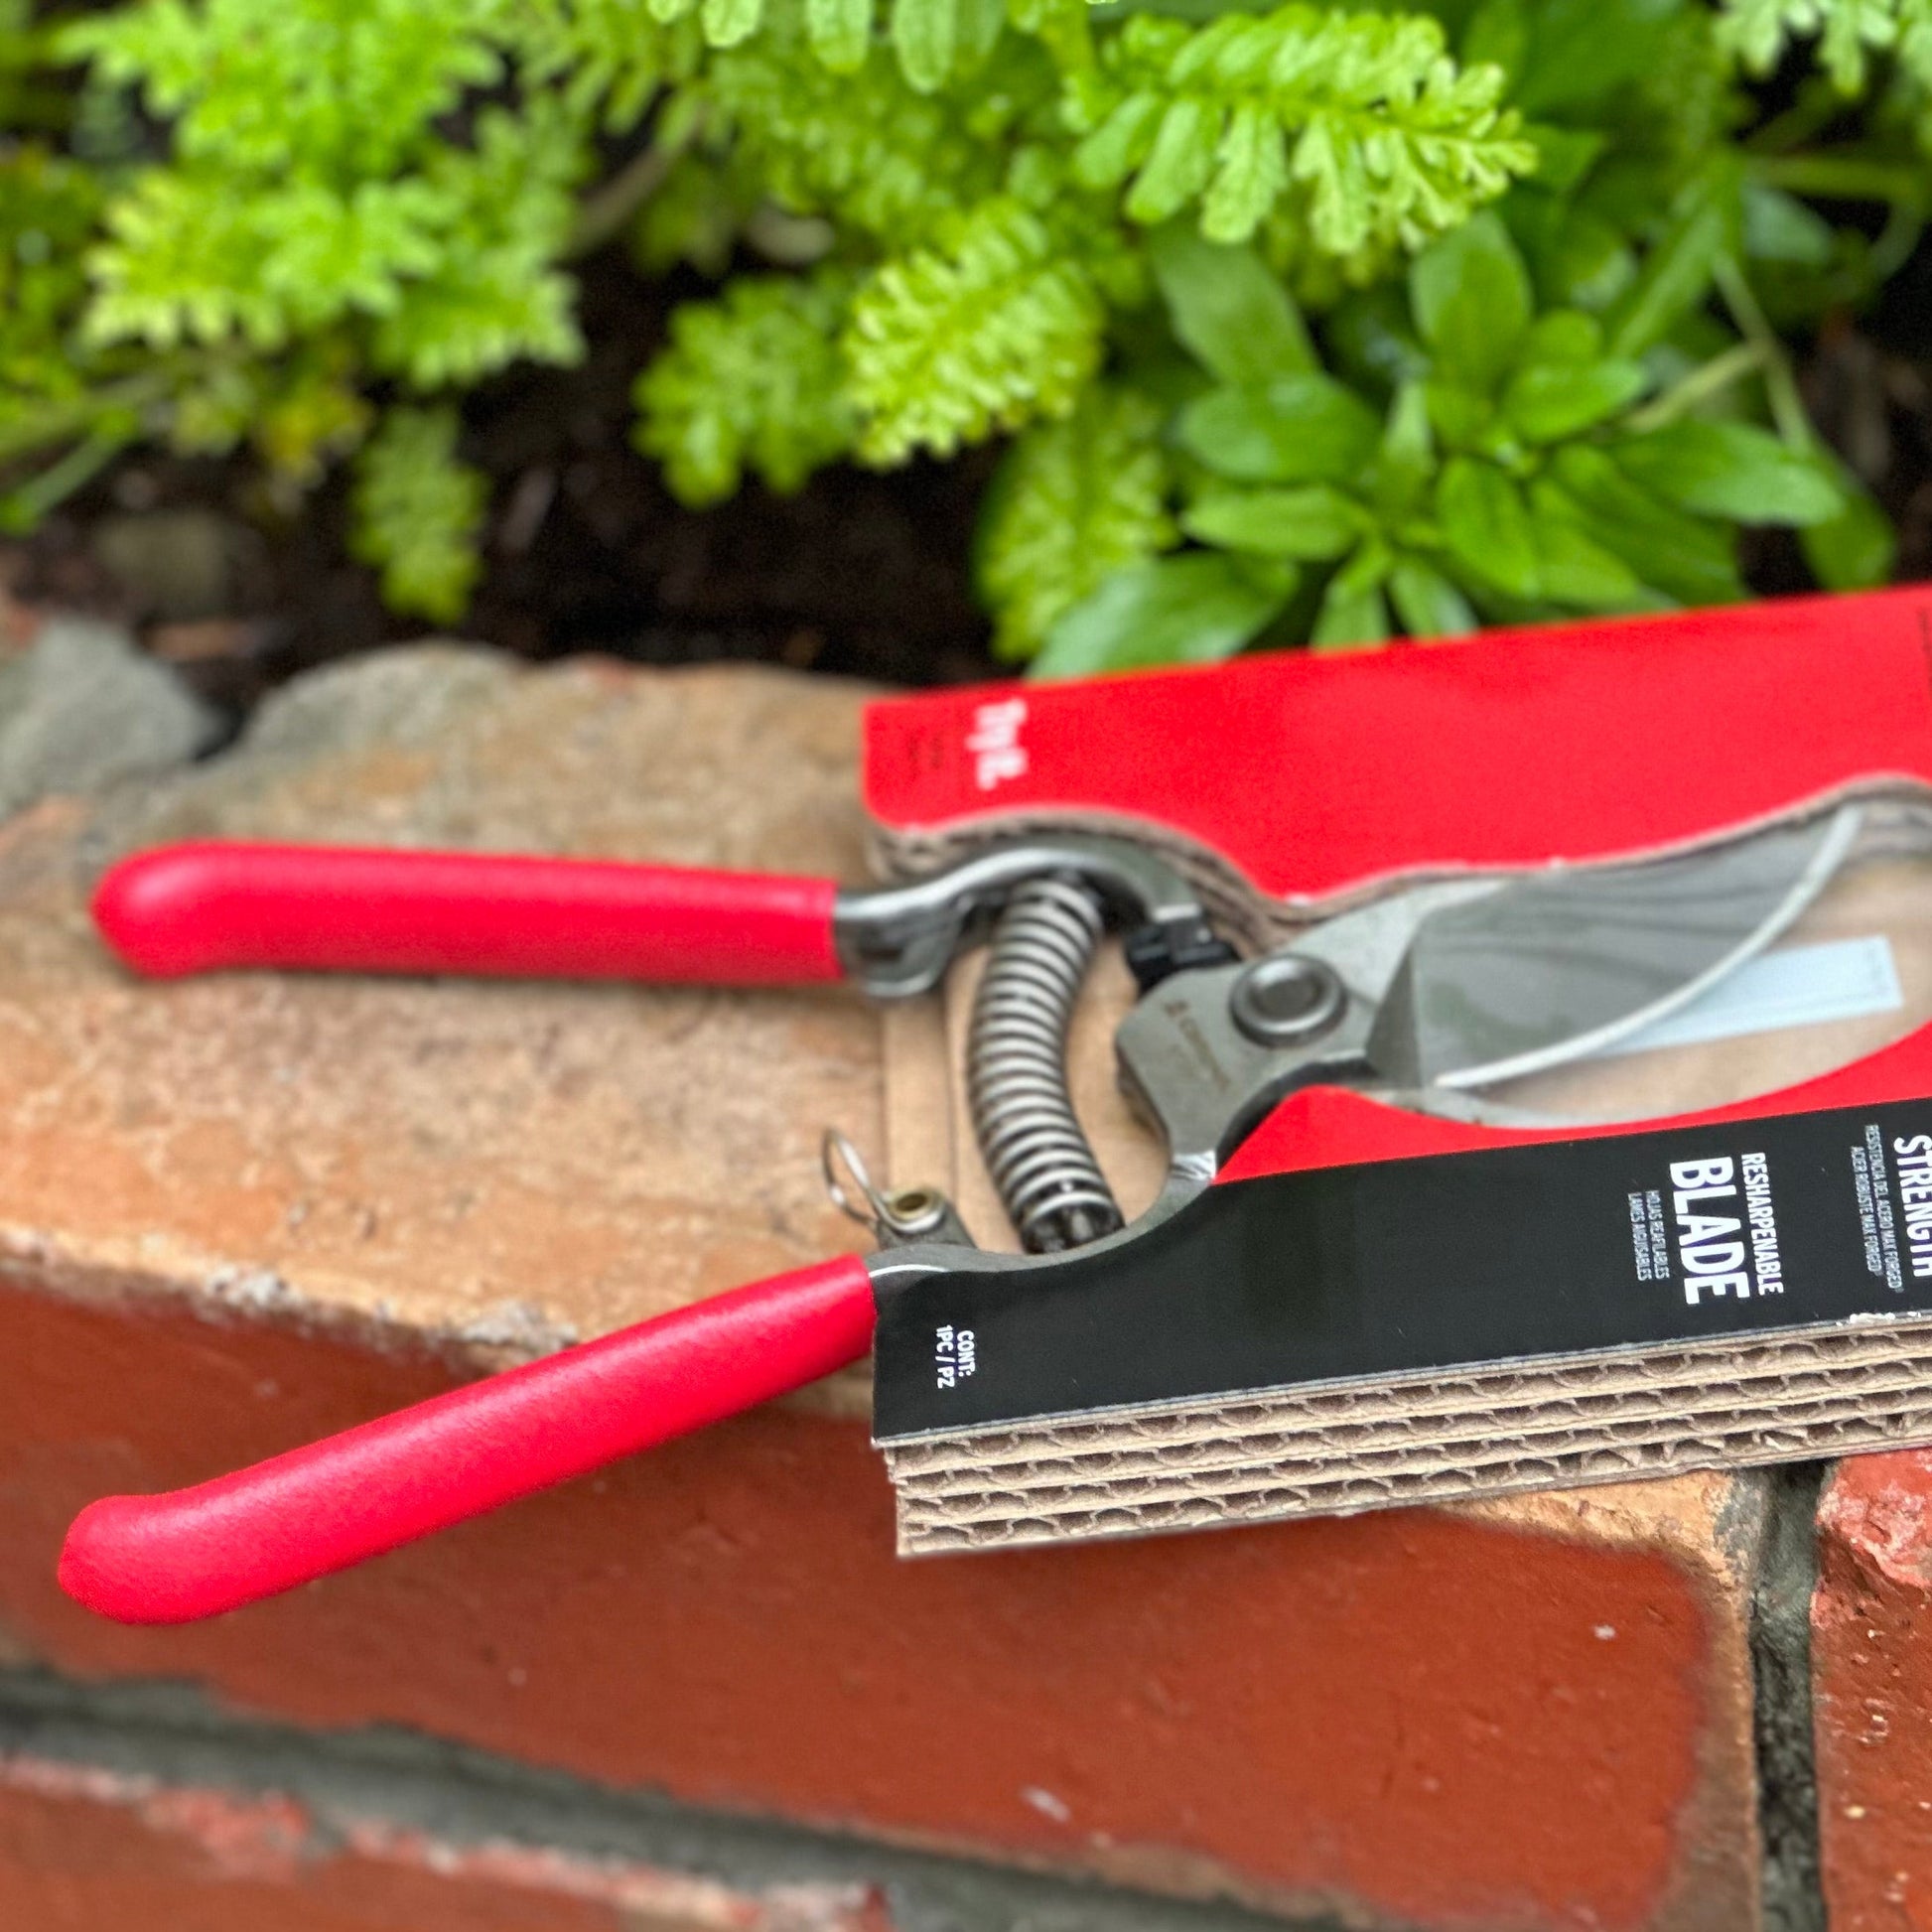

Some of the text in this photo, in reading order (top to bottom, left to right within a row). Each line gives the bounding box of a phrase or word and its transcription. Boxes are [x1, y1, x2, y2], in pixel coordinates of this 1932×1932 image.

[1865, 1124, 1885, 1180] RESISTENCIA
[1873, 1179, 1889, 1198] DEL
[1741, 1153, 1784, 1296] RESHARPENABLE
[1861, 1214, 1876, 1235] MAX
[1876, 1198, 1893, 1229] ACERO
[1670, 1157, 1750, 1305] BLADE
[1880, 1229, 1897, 1251] MAX
[936, 1324, 954, 1353] 1PC
[957, 1330, 976, 1377] CONT:
[937, 1366, 955, 1389] PZ
